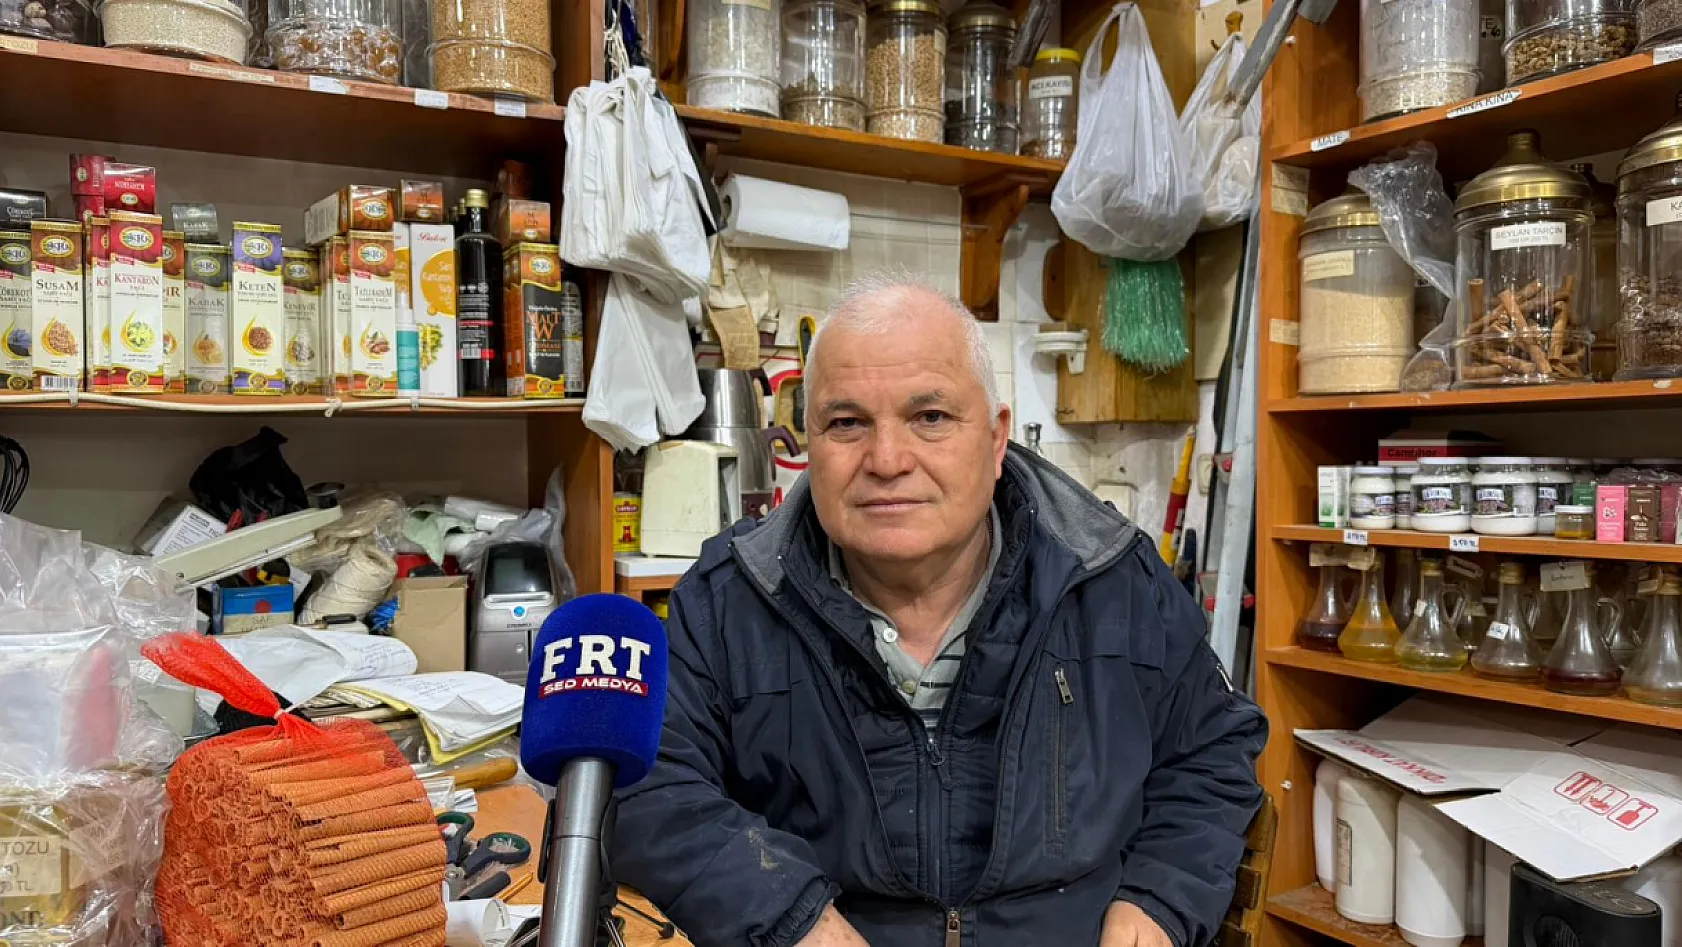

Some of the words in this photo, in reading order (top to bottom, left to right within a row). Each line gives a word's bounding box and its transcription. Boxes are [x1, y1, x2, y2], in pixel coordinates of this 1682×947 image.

[1485, 90, 1514, 107] KINA
[1316, 134, 1345, 148] MATE
[1495, 228, 1530, 239] SEYLAN
[1532, 226, 1563, 235] TARÇIN
[35, 279, 80, 292] SUSAM
[114, 272, 161, 286] KANTARON
[238, 280, 277, 292] KETEN
[188, 297, 225, 307] KABAK
[525, 311, 560, 324] MALT
[540, 634, 652, 684] FRT
[544, 680, 577, 695] SED
[581, 678, 644, 694] MEDYA
[1, 841, 50, 856] TOZU
[16, 880, 34, 891] TL
